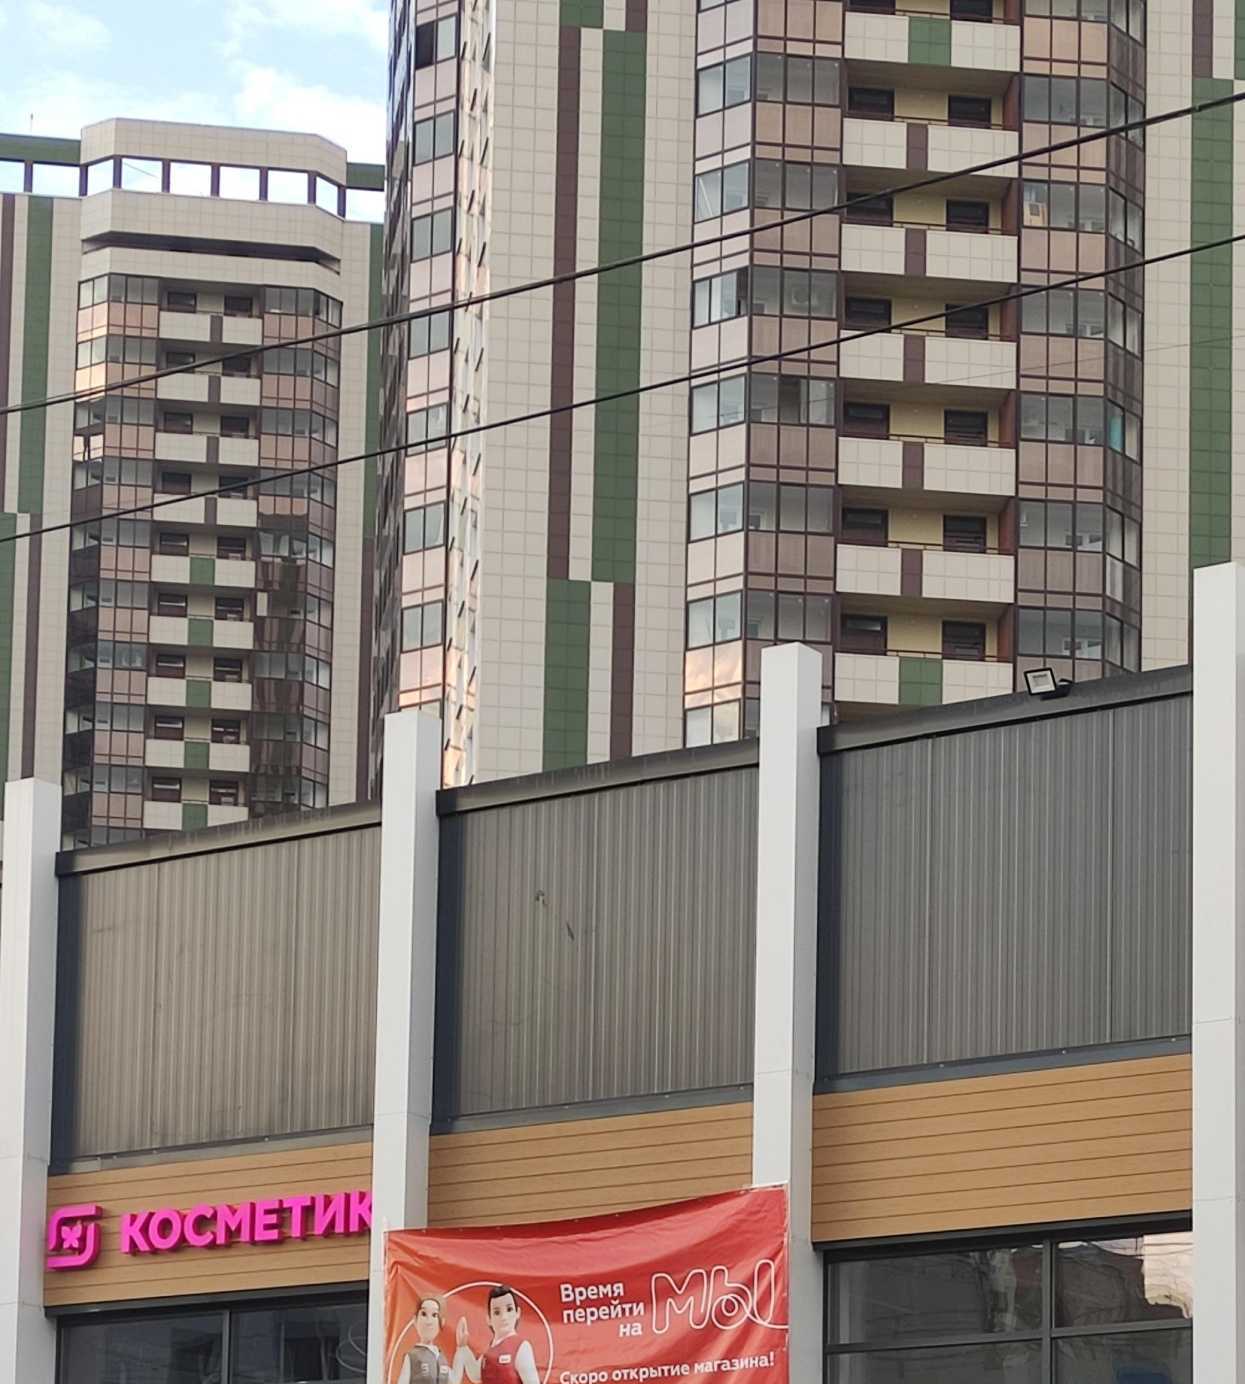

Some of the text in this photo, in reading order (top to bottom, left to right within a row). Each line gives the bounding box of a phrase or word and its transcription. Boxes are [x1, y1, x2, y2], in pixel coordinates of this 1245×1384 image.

[560, 1282, 625, 1306] Время
[562, 1299, 645, 1326] перейти
[619, 1322, 643, 1338] на
[611, 1364, 690, 1382] открытие
[693, 1351, 775, 1374] магазина!
